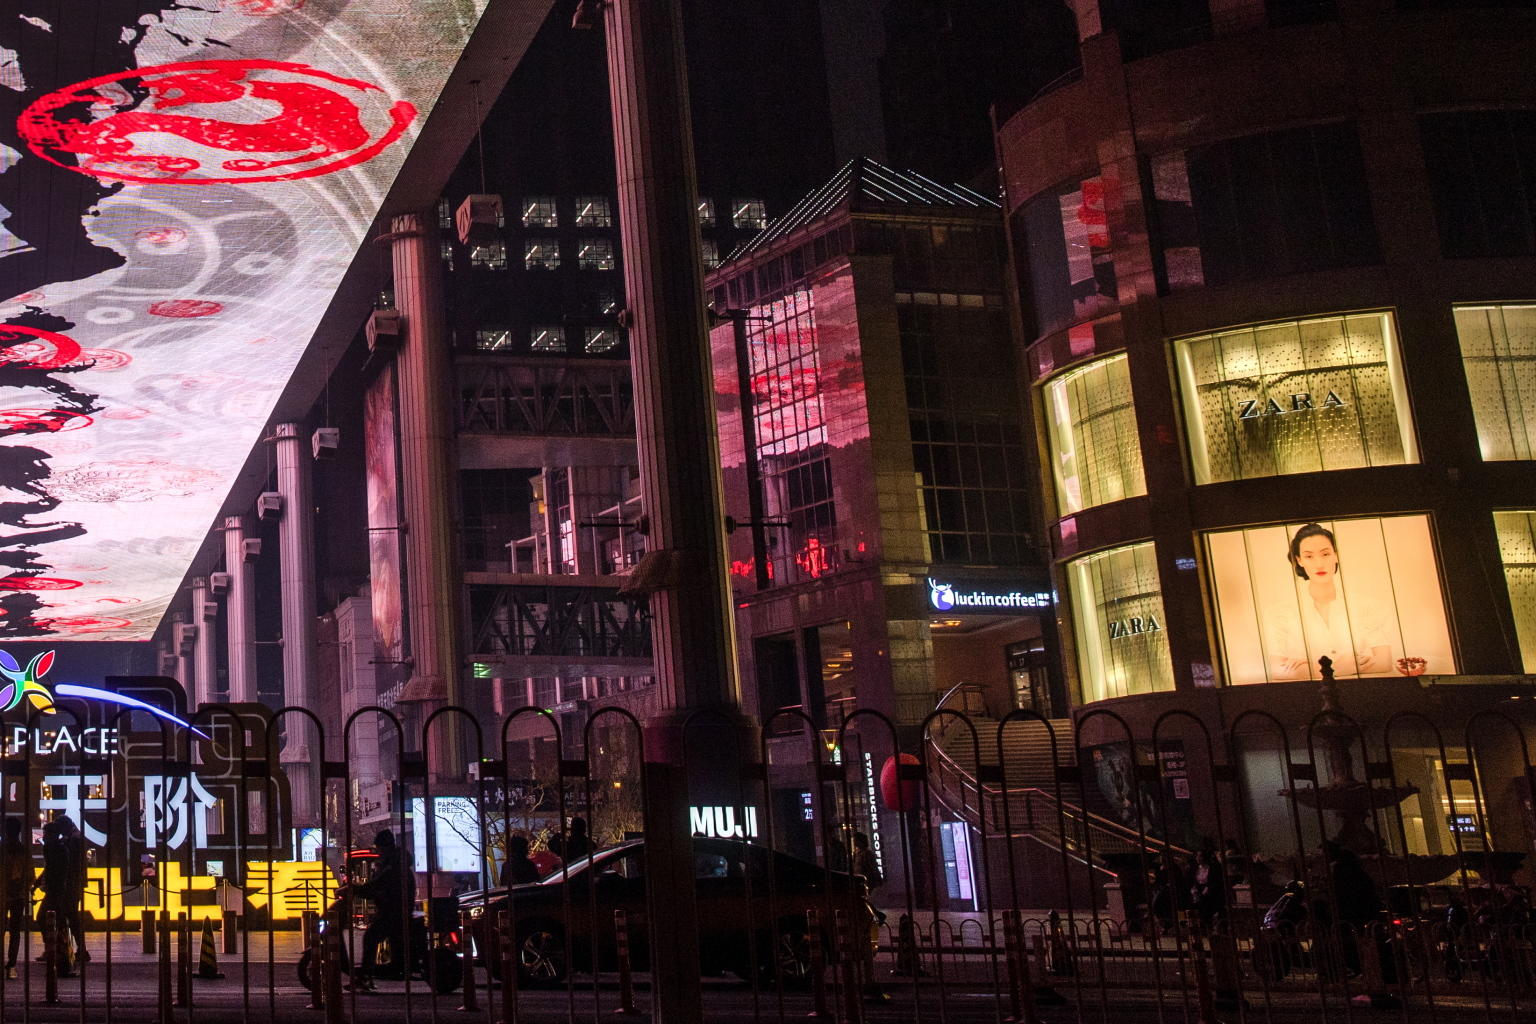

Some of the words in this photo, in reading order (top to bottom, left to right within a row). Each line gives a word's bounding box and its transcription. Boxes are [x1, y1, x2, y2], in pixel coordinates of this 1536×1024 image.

[1239, 391, 1346, 420] ZARA
[1110, 615, 1161, 640] ZARA
[14, 726, 118, 754] PLACE
[864, 752, 878, 830] STARBUCKS
[689, 806, 758, 838] MUJI
